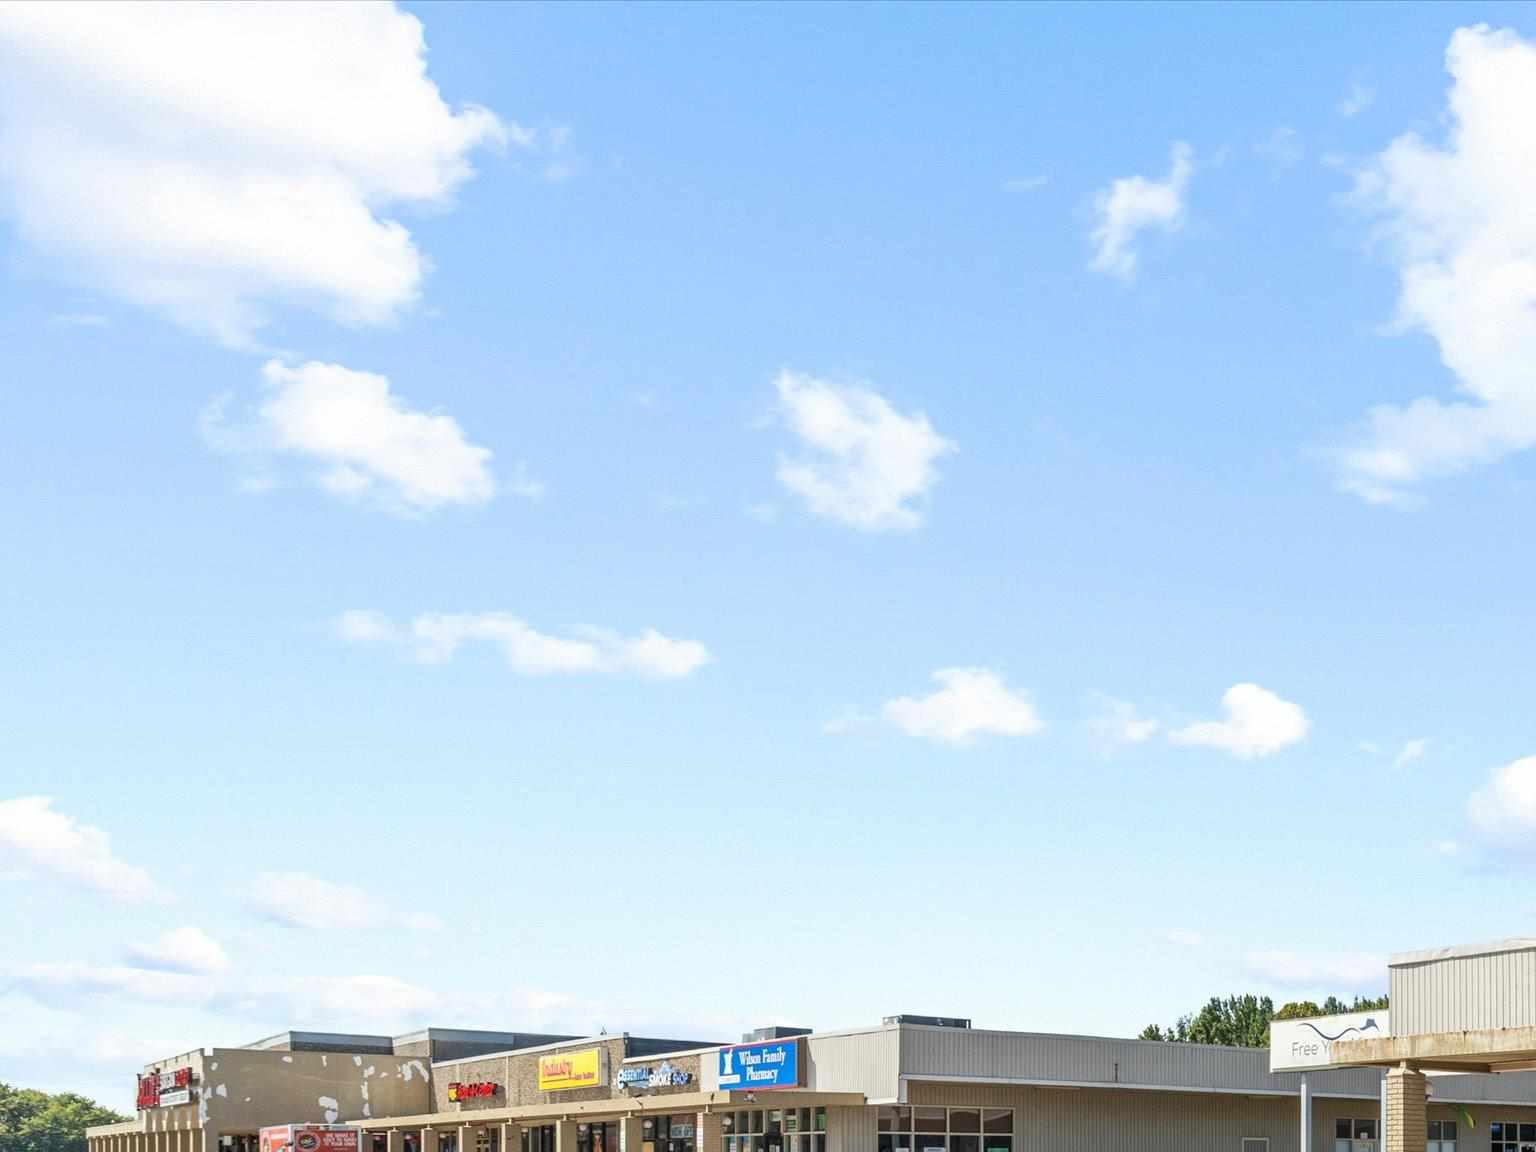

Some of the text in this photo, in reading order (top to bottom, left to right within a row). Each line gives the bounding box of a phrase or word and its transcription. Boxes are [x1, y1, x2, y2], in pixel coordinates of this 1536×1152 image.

[738, 1046, 787, 1066] Wilson Family
[1291, 1041, 1319, 1057] Free
[745, 1066, 779, 1083] Pharmacy
